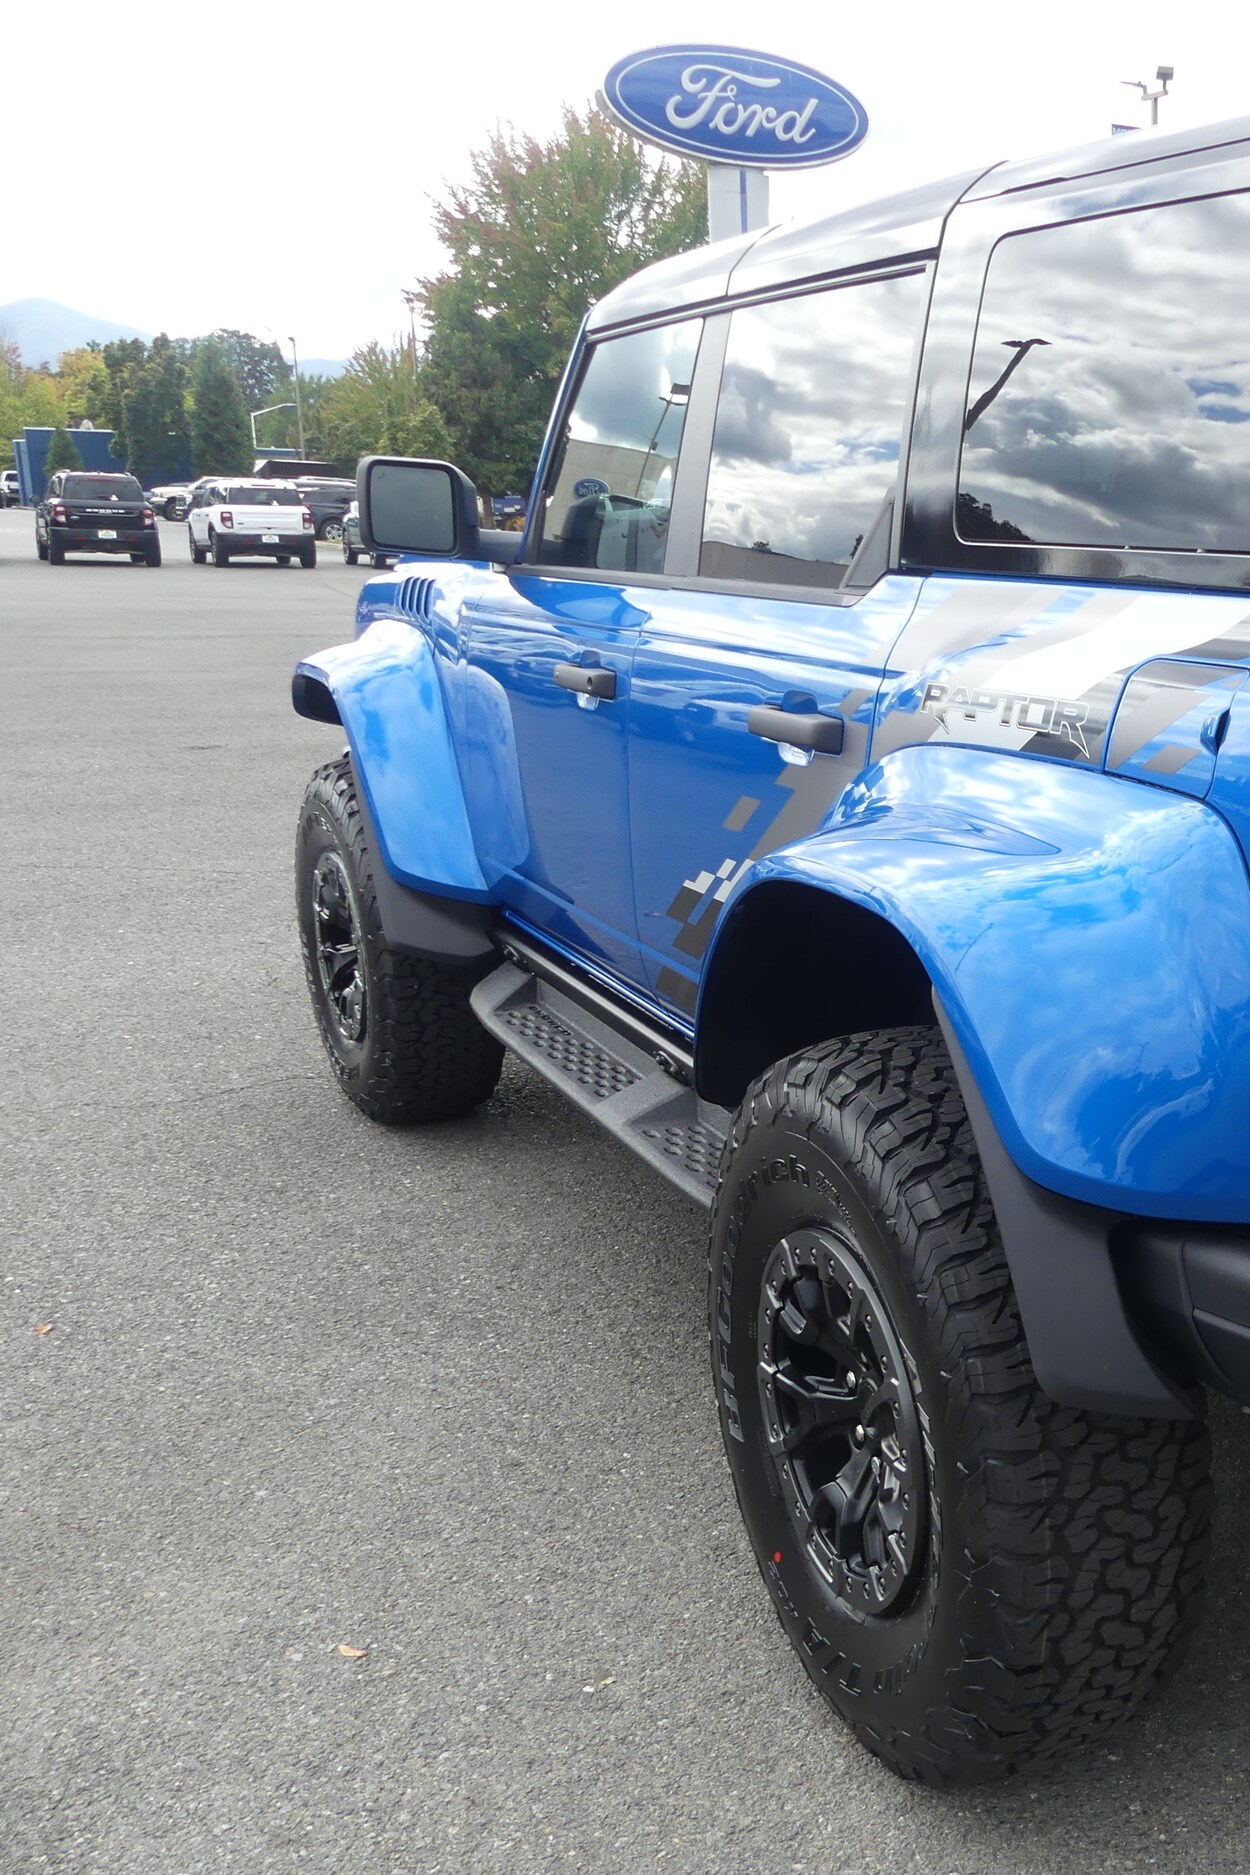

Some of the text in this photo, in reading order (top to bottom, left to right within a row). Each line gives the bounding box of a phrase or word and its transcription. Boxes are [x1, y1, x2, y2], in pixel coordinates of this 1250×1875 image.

[665, 64, 819, 144] Ford
[920, 681, 1090, 759] RAPTOR
[717, 1154, 810, 1442] BFGoodrich
